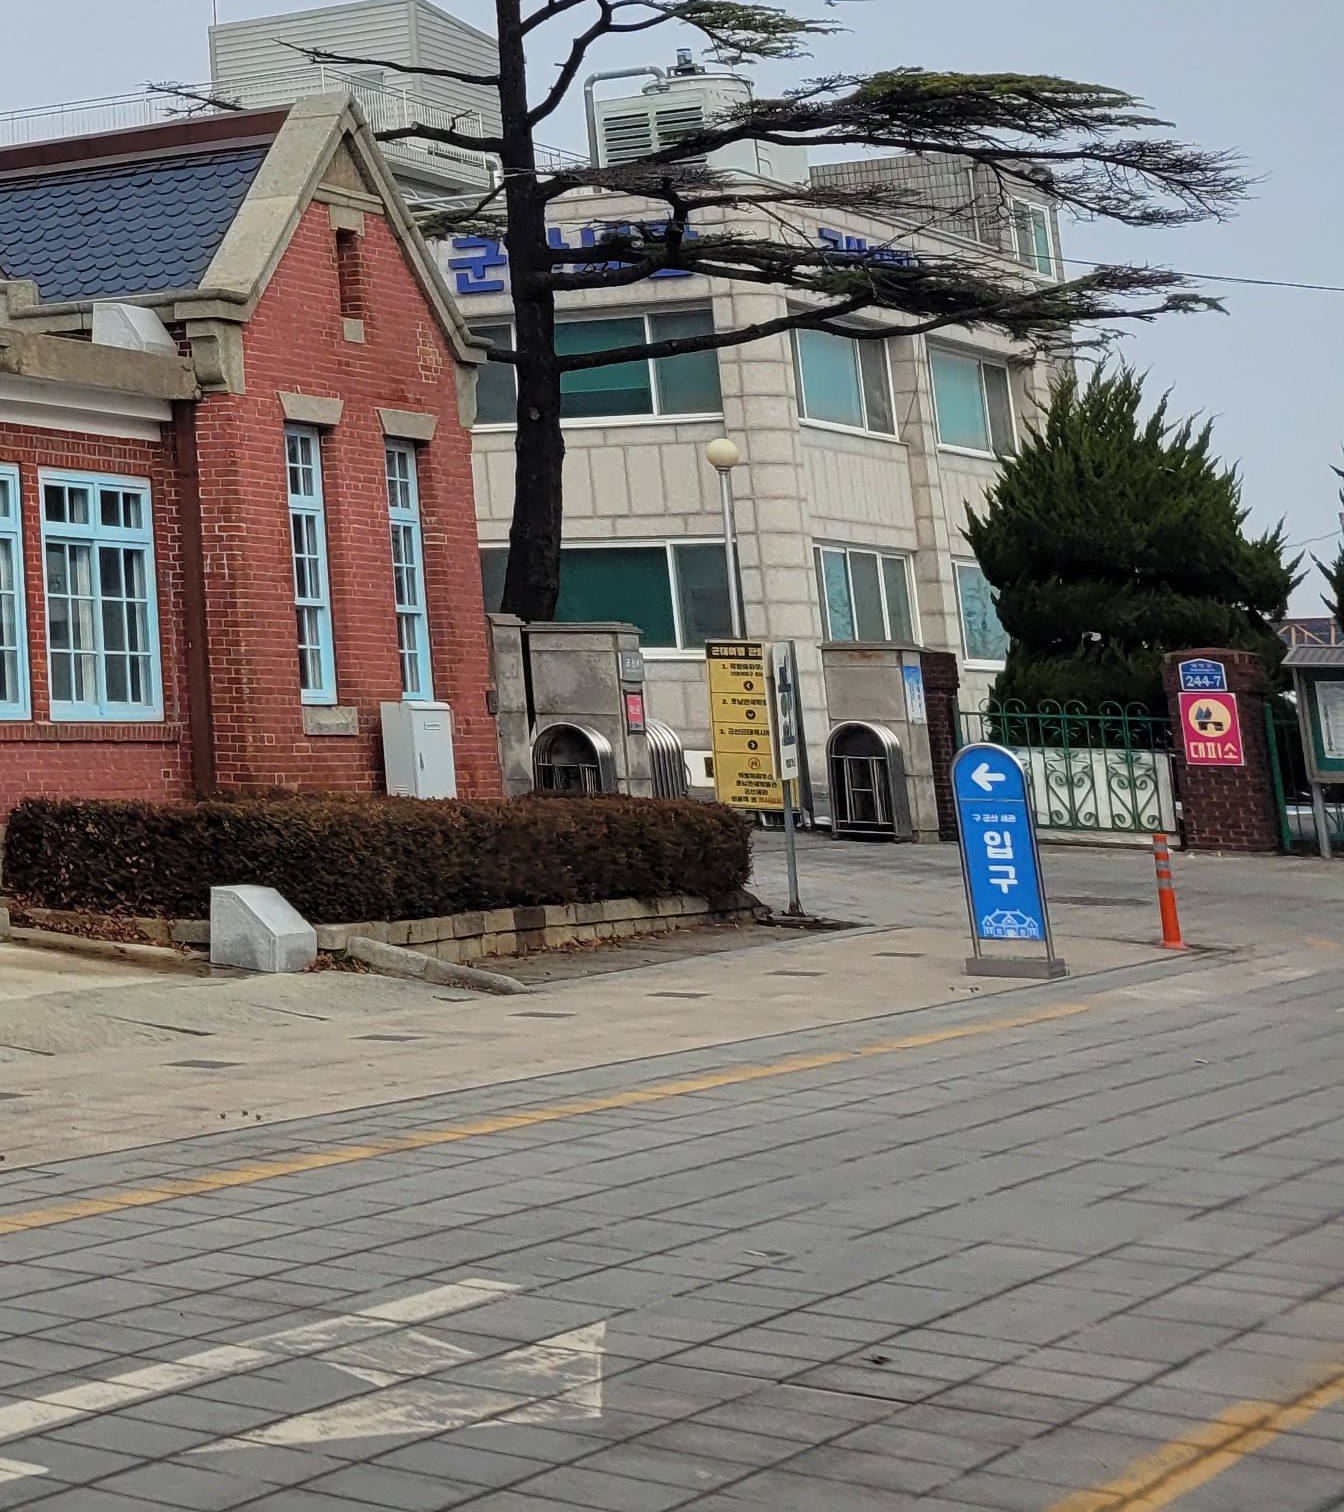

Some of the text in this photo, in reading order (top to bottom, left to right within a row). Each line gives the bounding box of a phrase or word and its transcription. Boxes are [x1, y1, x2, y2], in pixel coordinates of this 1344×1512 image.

[1185, 675, 1222, 688] 244-7
[1189, 741, 1240, 760] 대피소
[972, 813, 981, 823] 구
[983, 830, 1019, 895] 입구
